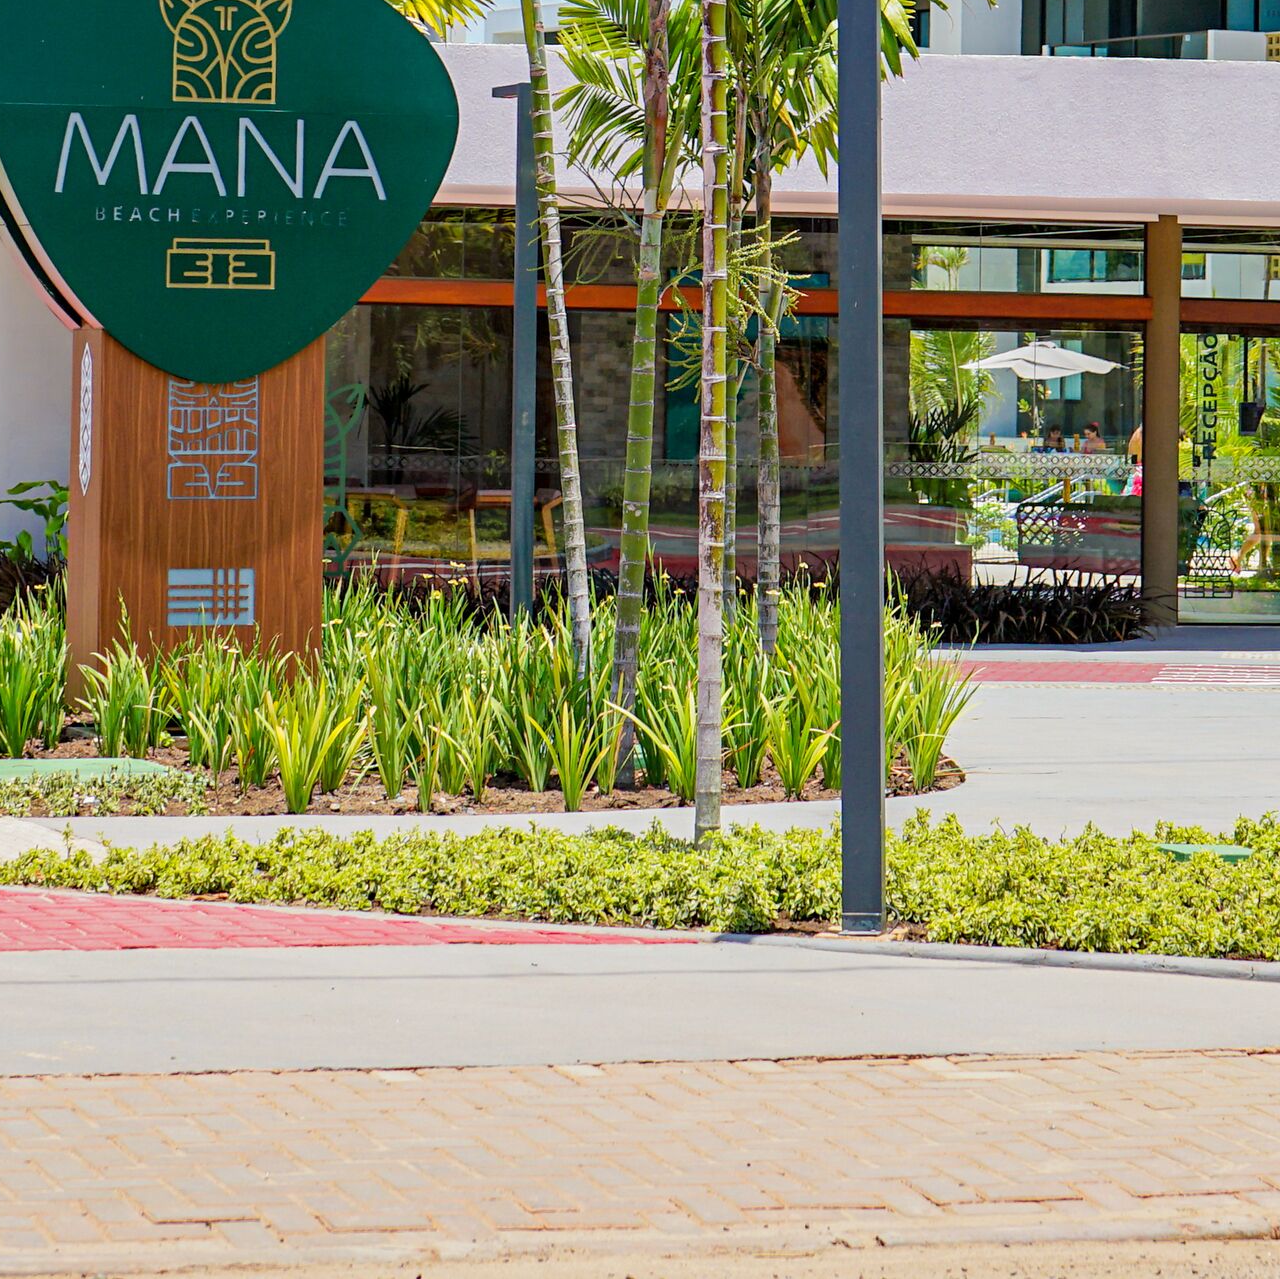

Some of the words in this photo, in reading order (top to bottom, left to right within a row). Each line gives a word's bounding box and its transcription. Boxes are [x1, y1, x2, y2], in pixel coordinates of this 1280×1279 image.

[54, 111, 387, 201] MANA
[95, 205, 181, 223] BEACH
[1199, 332, 1220, 461] RECEPÇÃO
